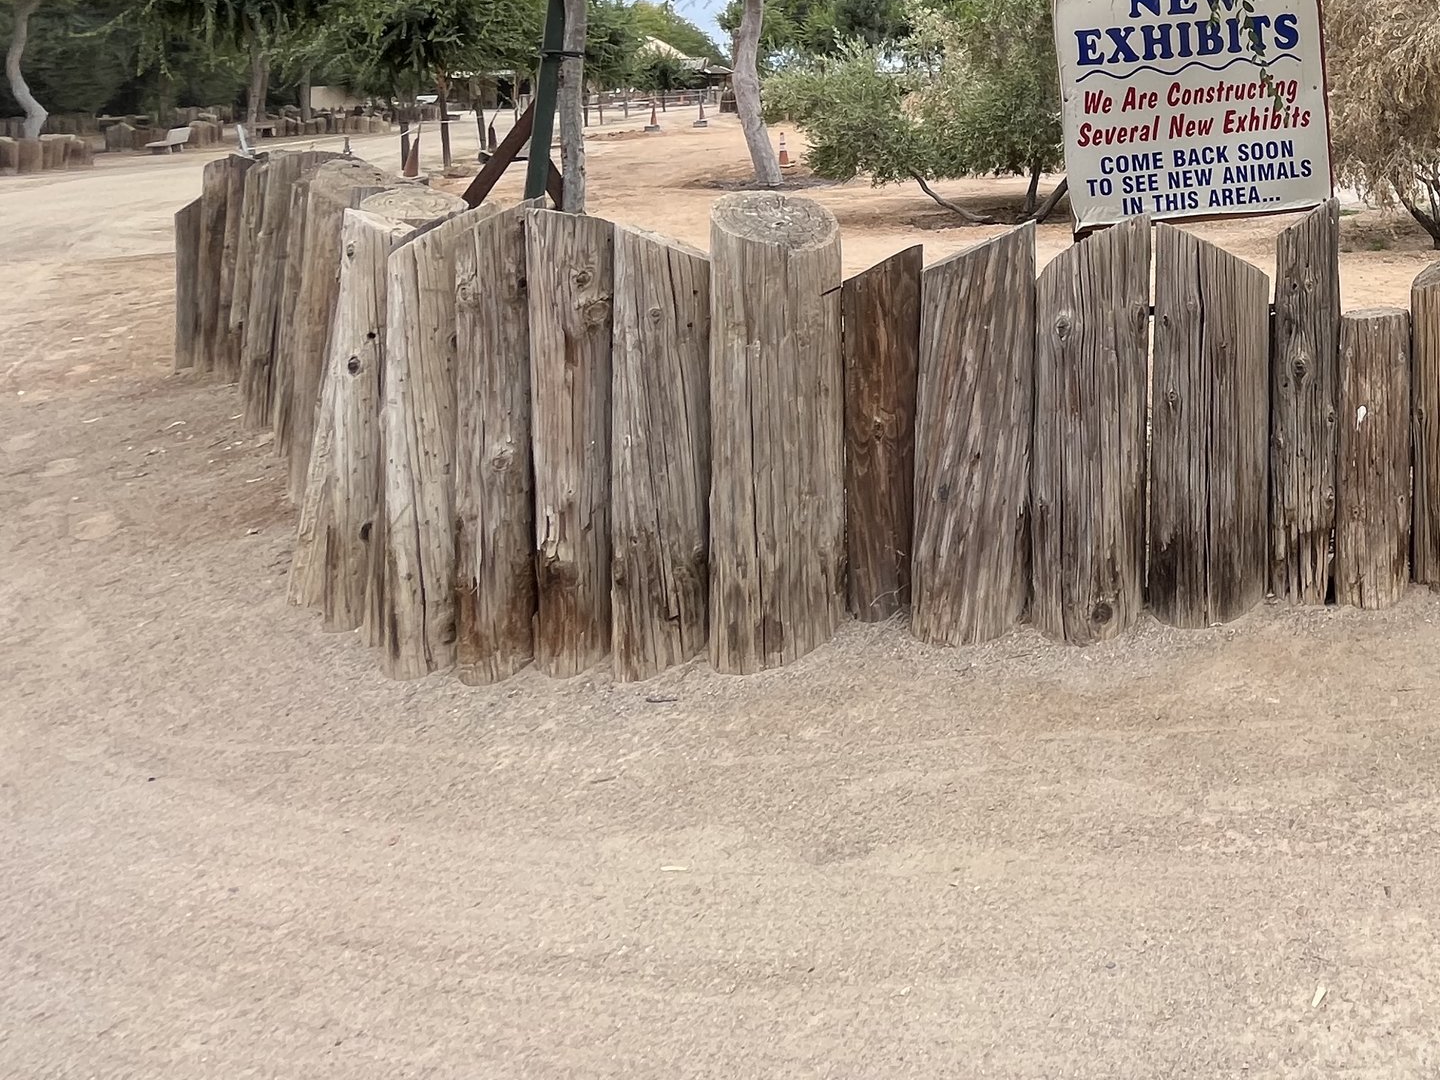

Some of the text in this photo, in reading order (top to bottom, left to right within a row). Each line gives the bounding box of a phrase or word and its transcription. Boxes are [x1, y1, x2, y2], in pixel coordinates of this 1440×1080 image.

[1074, 13, 1299, 65] EXHIBITS
[1084, 79, 1297, 115] We Are Constructng
[1077, 115, 1160, 147] Several
[1168, 113, 1214, 140] New
[1100, 139, 1294, 175] COME BACK SOON
[1086, 159, 1313, 197] TO SEE NEW ANIMALS
[1122, 196, 1144, 216] IN
[1152, 190, 1199, 213] THIS
